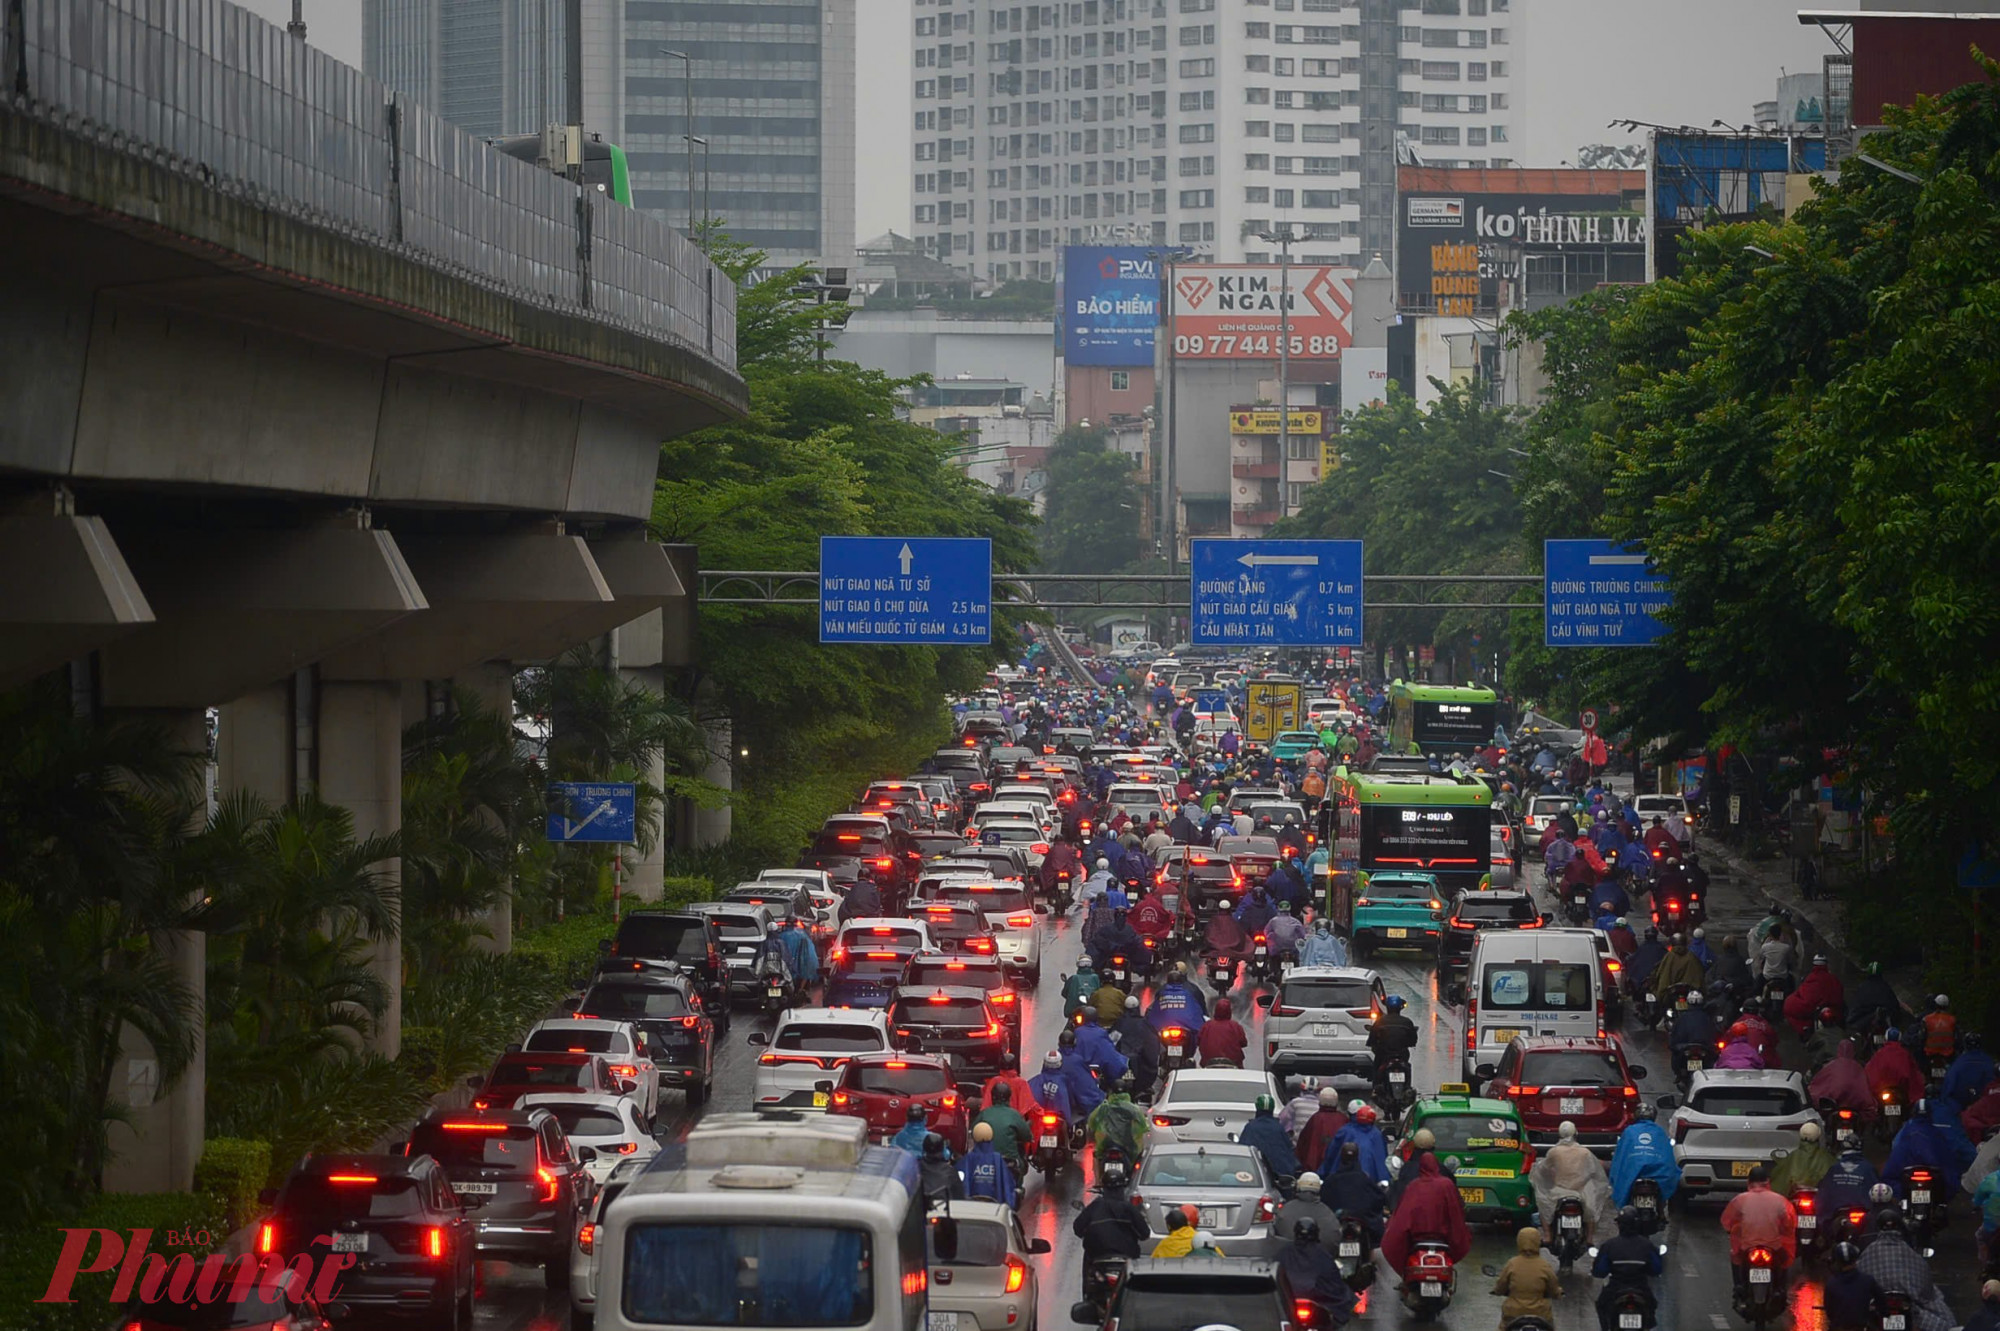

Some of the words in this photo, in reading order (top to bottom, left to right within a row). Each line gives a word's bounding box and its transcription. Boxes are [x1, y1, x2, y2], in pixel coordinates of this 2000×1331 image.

[1120, 260, 1153, 273] PVI
[1219, 276, 1268, 292] KIM
[1077, 296, 1112, 314] BẢO
[1116, 293, 1153, 314] HIỂM
[1219, 294, 1295, 310] NGAN
[1218, 323, 1236, 331] LIÊN
[1236, 323, 1246, 332] HỆ
[1248, 323, 1275, 331] QUẢNG
[1175, 335, 1204, 354] 09
[1208, 336, 1237, 354] 77
[1240, 336, 1269, 354] 44
[1309, 336, 1338, 355] 88
[825, 575, 844, 591] NÚT
[848, 579, 870, 591] GIAO
[875, 577, 894, 591] NGÃ
[900, 579, 913, 591] TƯ
[917, 575, 931, 591] SỞ
[1200, 578, 1235, 594] ĐƯỜNG
[1338, 581, 1353, 594] km
[1552, 578, 1586, 593] ĐƯỜNG
[1590, 578, 1630, 593] TRƯỜNG
[825, 597, 844, 612] NÚT
[848, 600, 870, 612] GIAO
[875, 598, 880, 612] Ô
[884, 600, 905, 615] CHỢ
[909, 597, 929, 613] DỪA
[952, 602, 967, 614] 2,5
[971, 601, 986, 613] km
[1200, 600, 1220, 615] NÚT
[1223, 603, 1246, 615] GIAO
[1250, 600, 1269, 615] CẦU
[1328, 603, 1334, 615] 5
[1338, 603, 1353, 615] km
[1552, 600, 1571, 615] NÚT
[1575, 603, 1597, 616] GIAO
[1600, 600, 1620, 615] NGÃ
[1624, 603, 1637, 615] TƯ
[825, 618, 844, 634] VĂN
[848, 618, 871, 634] MIẾU
[875, 618, 901, 634] QUỐC
[904, 618, 917, 634] TỬ
[921, 618, 945, 634] GIÁM
[952, 623, 967, 635] 4,3
[971, 623, 986, 635] km
[1200, 621, 1220, 637] CẦU
[1224, 622, 1250, 638] NHẬT
[1255, 623, 1274, 636] TÂN
[1325, 625, 1334, 636] 11
[1338, 625, 1353, 636] km
[1552, 621, 1571, 637] CẦU
[1576, 622, 1599, 636] VĨNH
